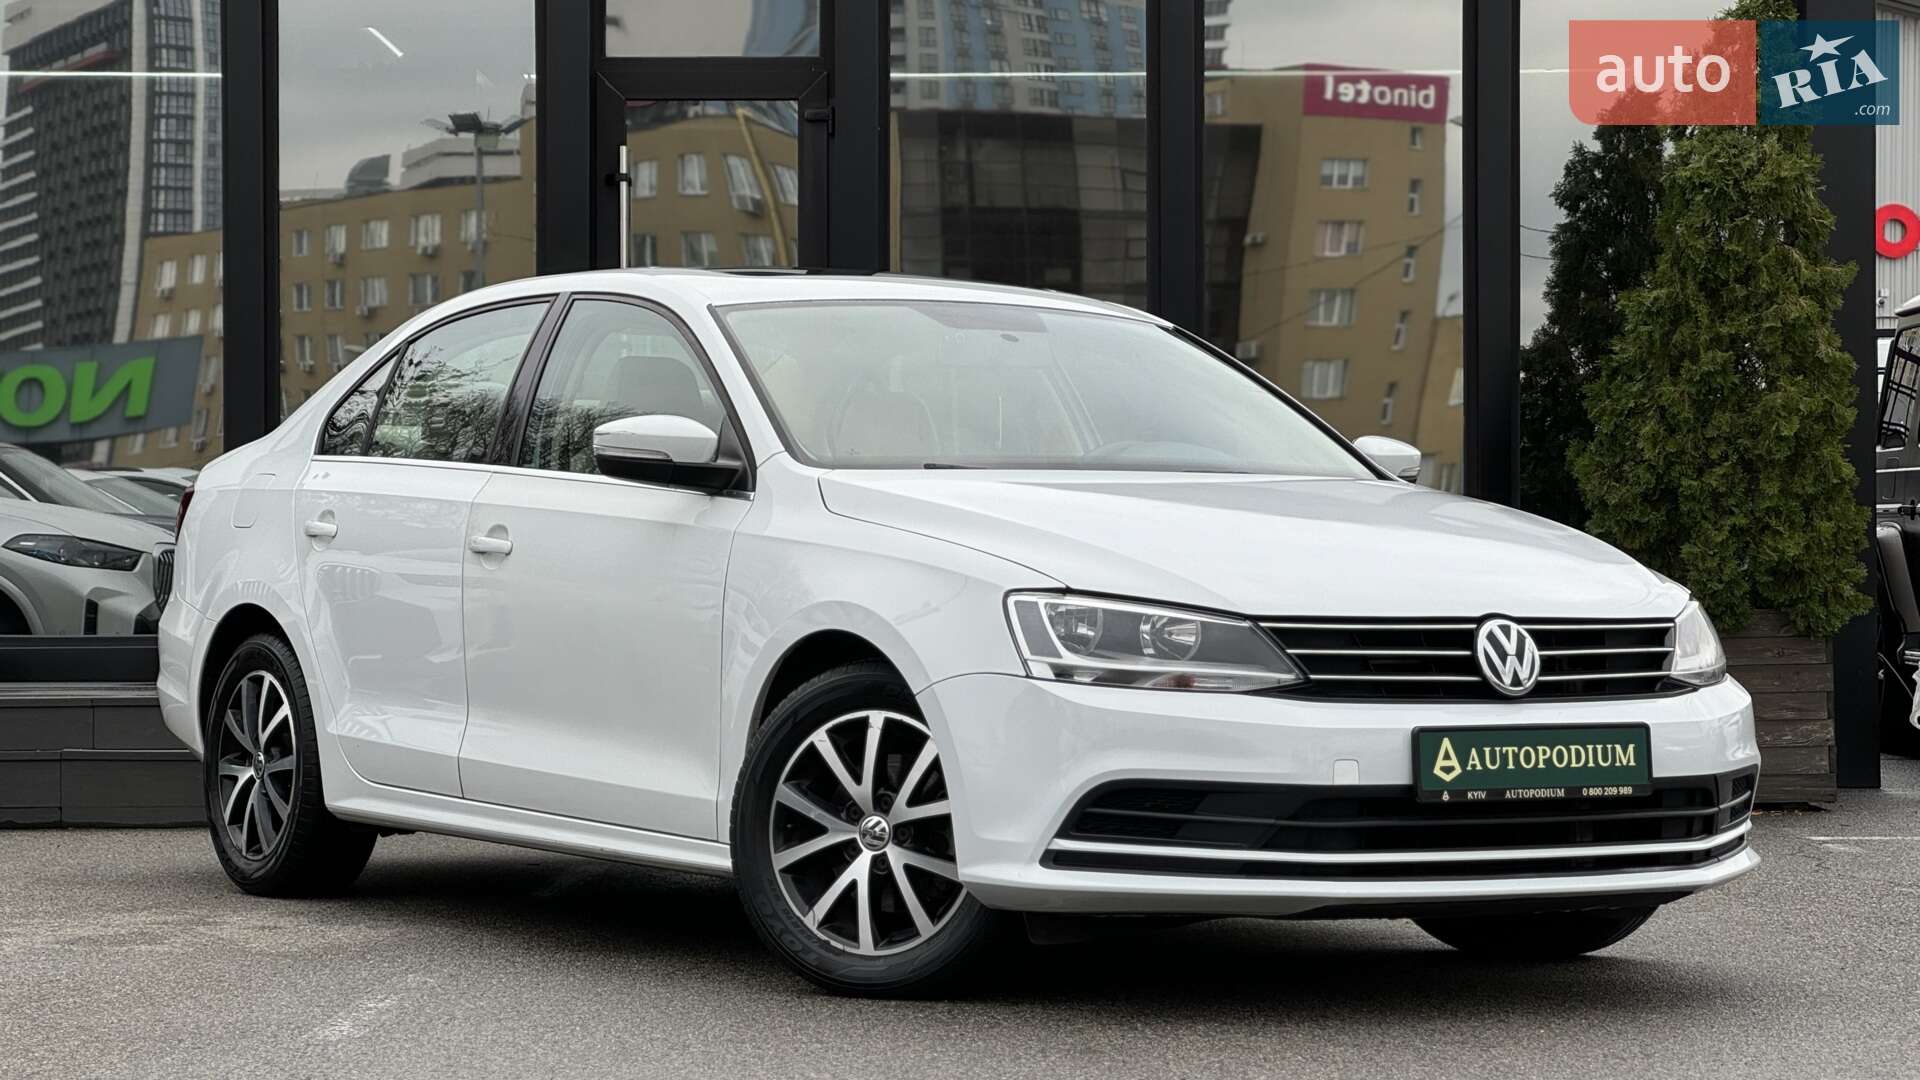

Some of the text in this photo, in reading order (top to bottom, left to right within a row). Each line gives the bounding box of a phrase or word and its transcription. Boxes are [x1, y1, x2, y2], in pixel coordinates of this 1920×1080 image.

[1466, 743, 1636, 771] AUTOPODIUM
[1467, 790, 1487, 799] KYIV
[1505, 787, 1565, 799] AUTOPODIUM
[1588, 787, 1603, 796] 800
[1604, 786, 1618, 796] 209
[1619, 785, 1633, 795] 989
